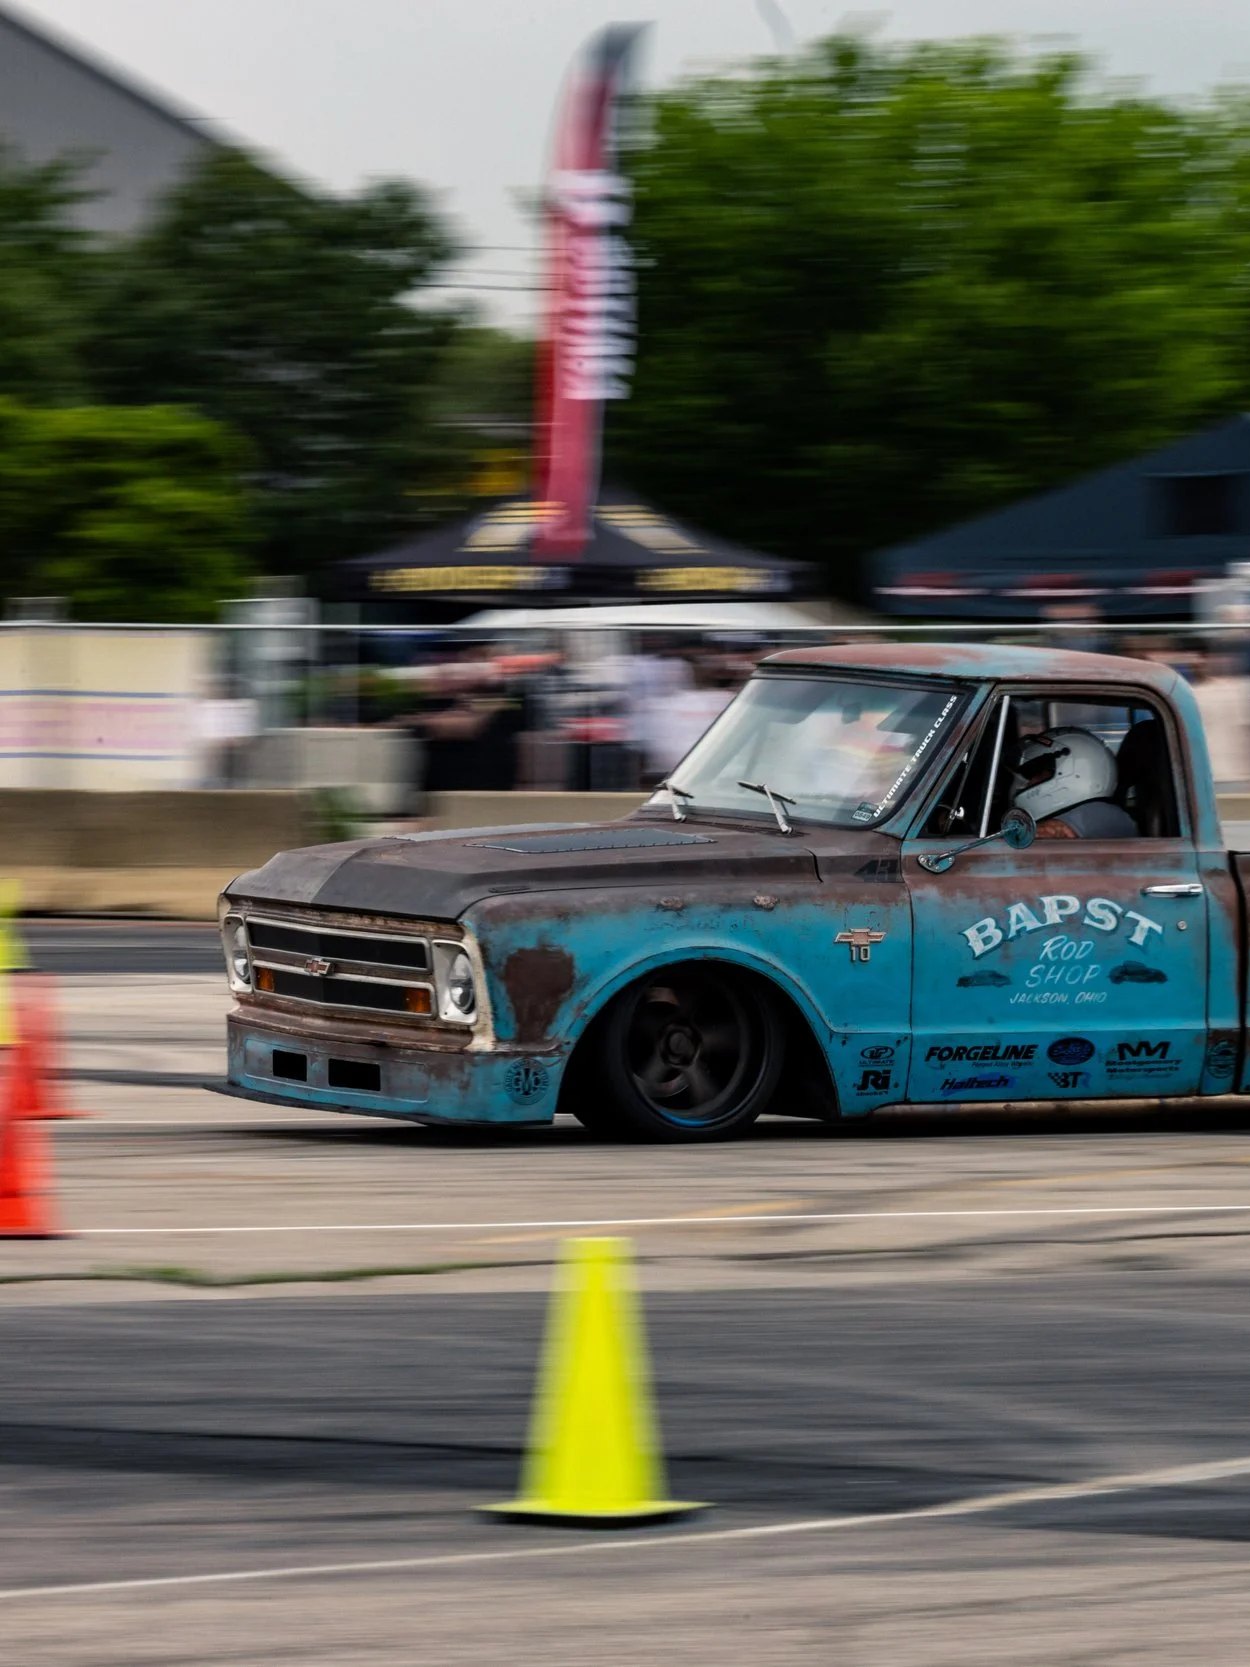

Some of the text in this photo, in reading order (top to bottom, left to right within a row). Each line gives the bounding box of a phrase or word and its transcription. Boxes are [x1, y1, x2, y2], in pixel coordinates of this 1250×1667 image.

[874, 695, 957, 817] ULTIMATE TRUCK CLASS
[961, 894, 1164, 957] BAPST
[850, 945, 870, 961] 10
[1039, 934, 1095, 962] ROD
[1025, 964, 1102, 988] SHOP
[1075, 991, 1108, 1004] OHIO
[924, 1044, 1038, 1062] FORGELINE
[939, 1076, 1010, 1091] Haltech
